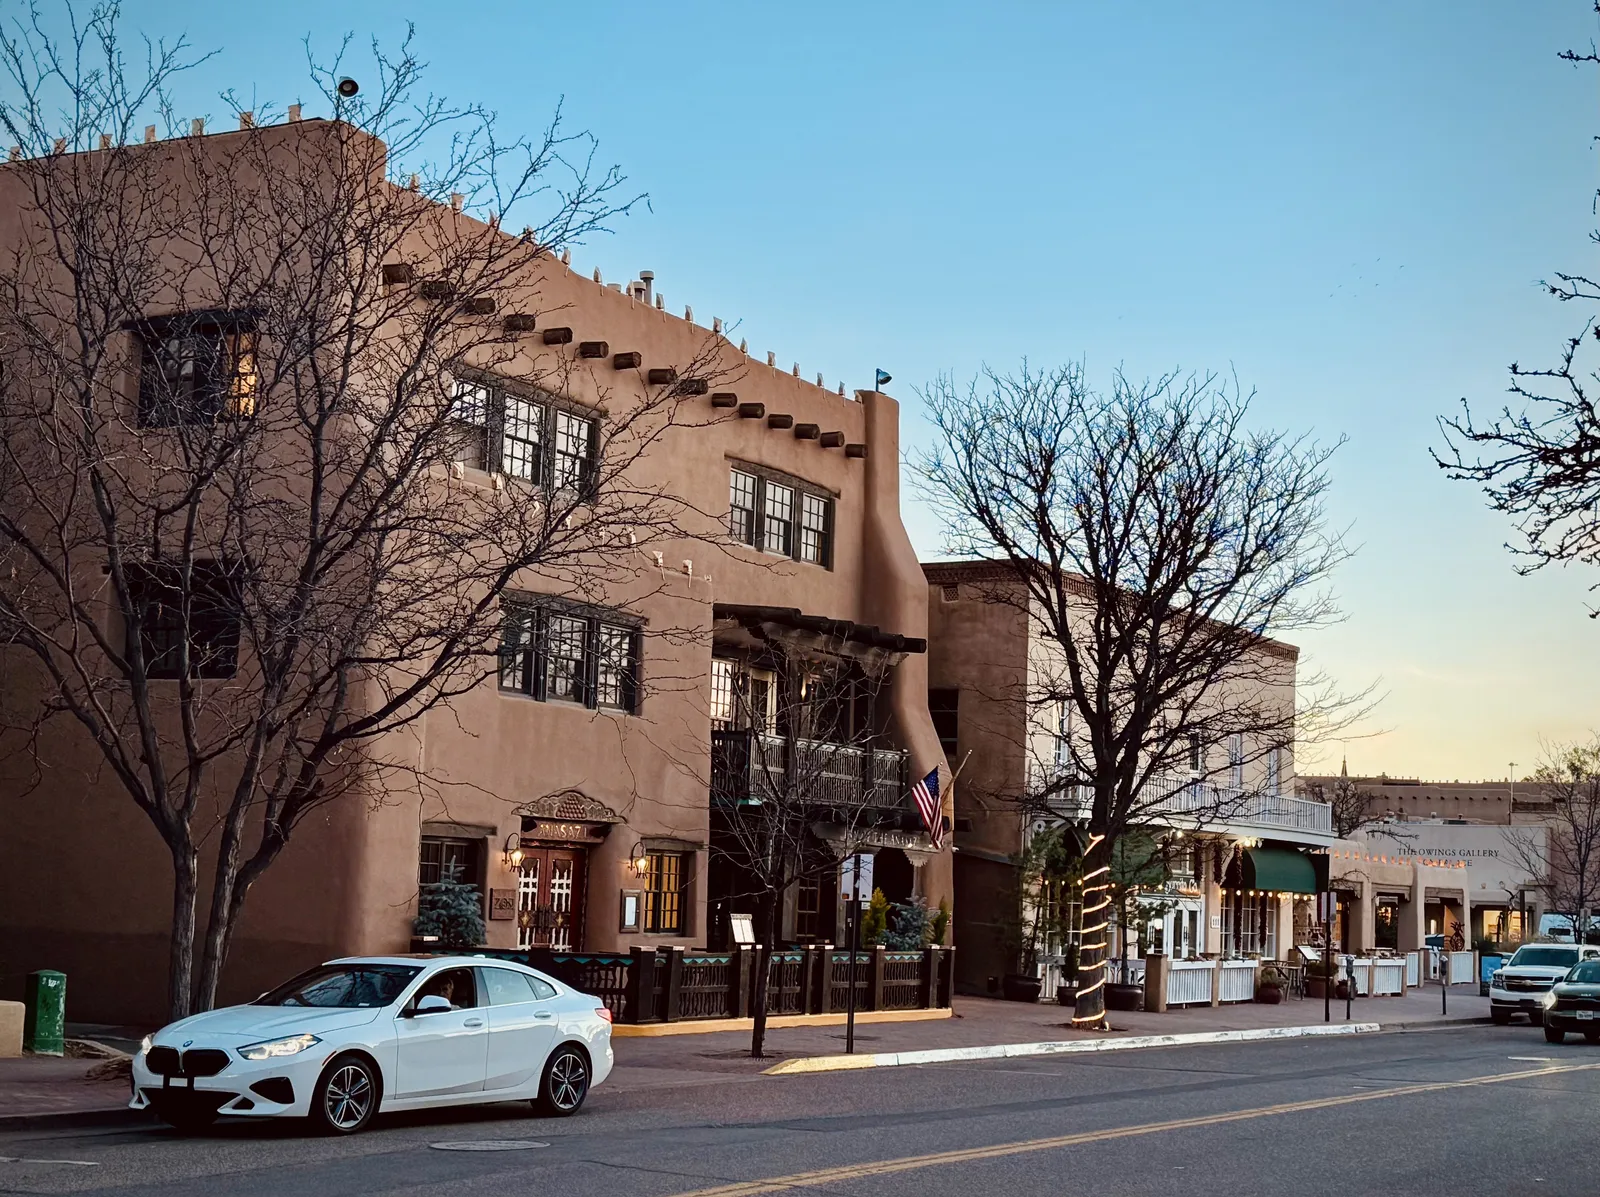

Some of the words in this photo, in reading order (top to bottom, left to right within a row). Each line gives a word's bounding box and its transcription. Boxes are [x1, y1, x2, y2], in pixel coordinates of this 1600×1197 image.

[537, 823, 587, 839] ANASAZI
[1397, 848, 1417, 856] THE
[1418, 848, 1456, 857] OWINGS
[1458, 848, 1500, 857] GALLERY
